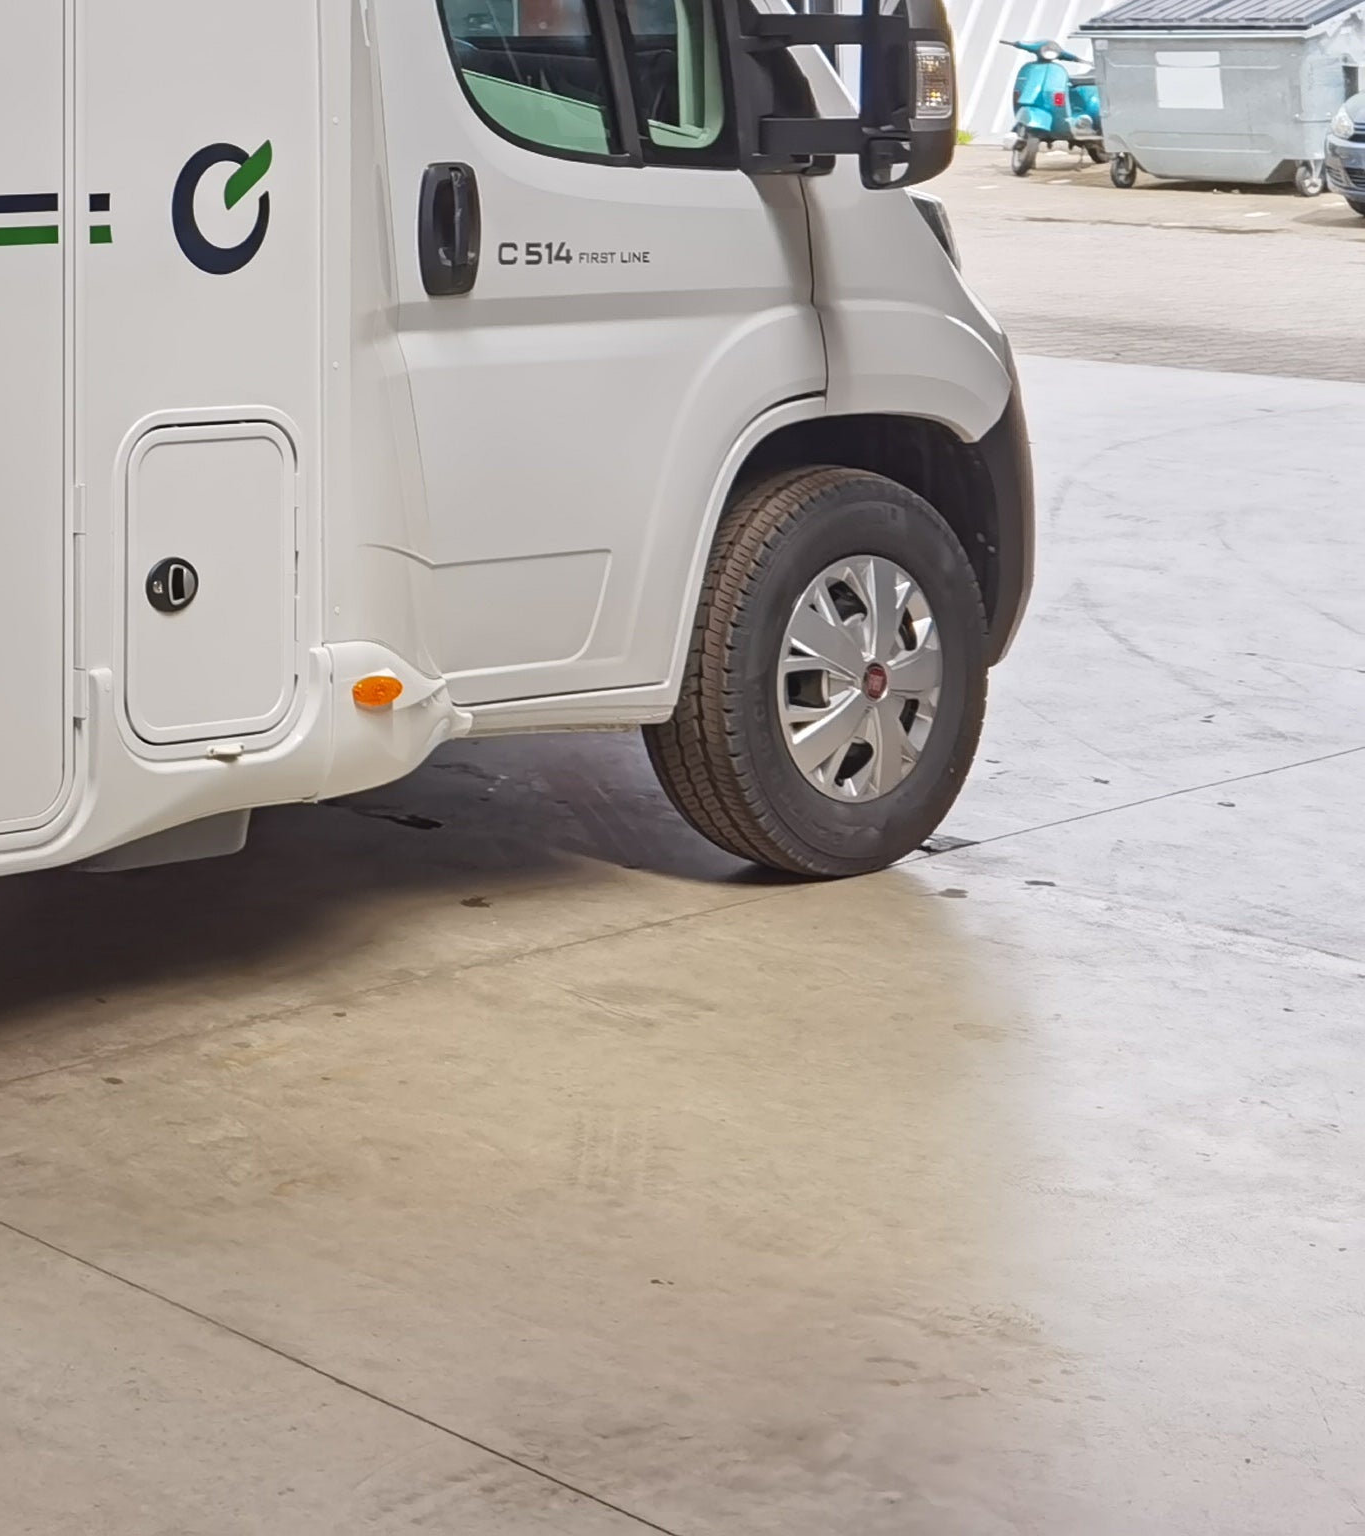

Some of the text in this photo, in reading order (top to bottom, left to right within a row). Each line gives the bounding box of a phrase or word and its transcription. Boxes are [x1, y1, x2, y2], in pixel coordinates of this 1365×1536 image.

[498, 242, 651, 265] C 514 FIRST LINE
